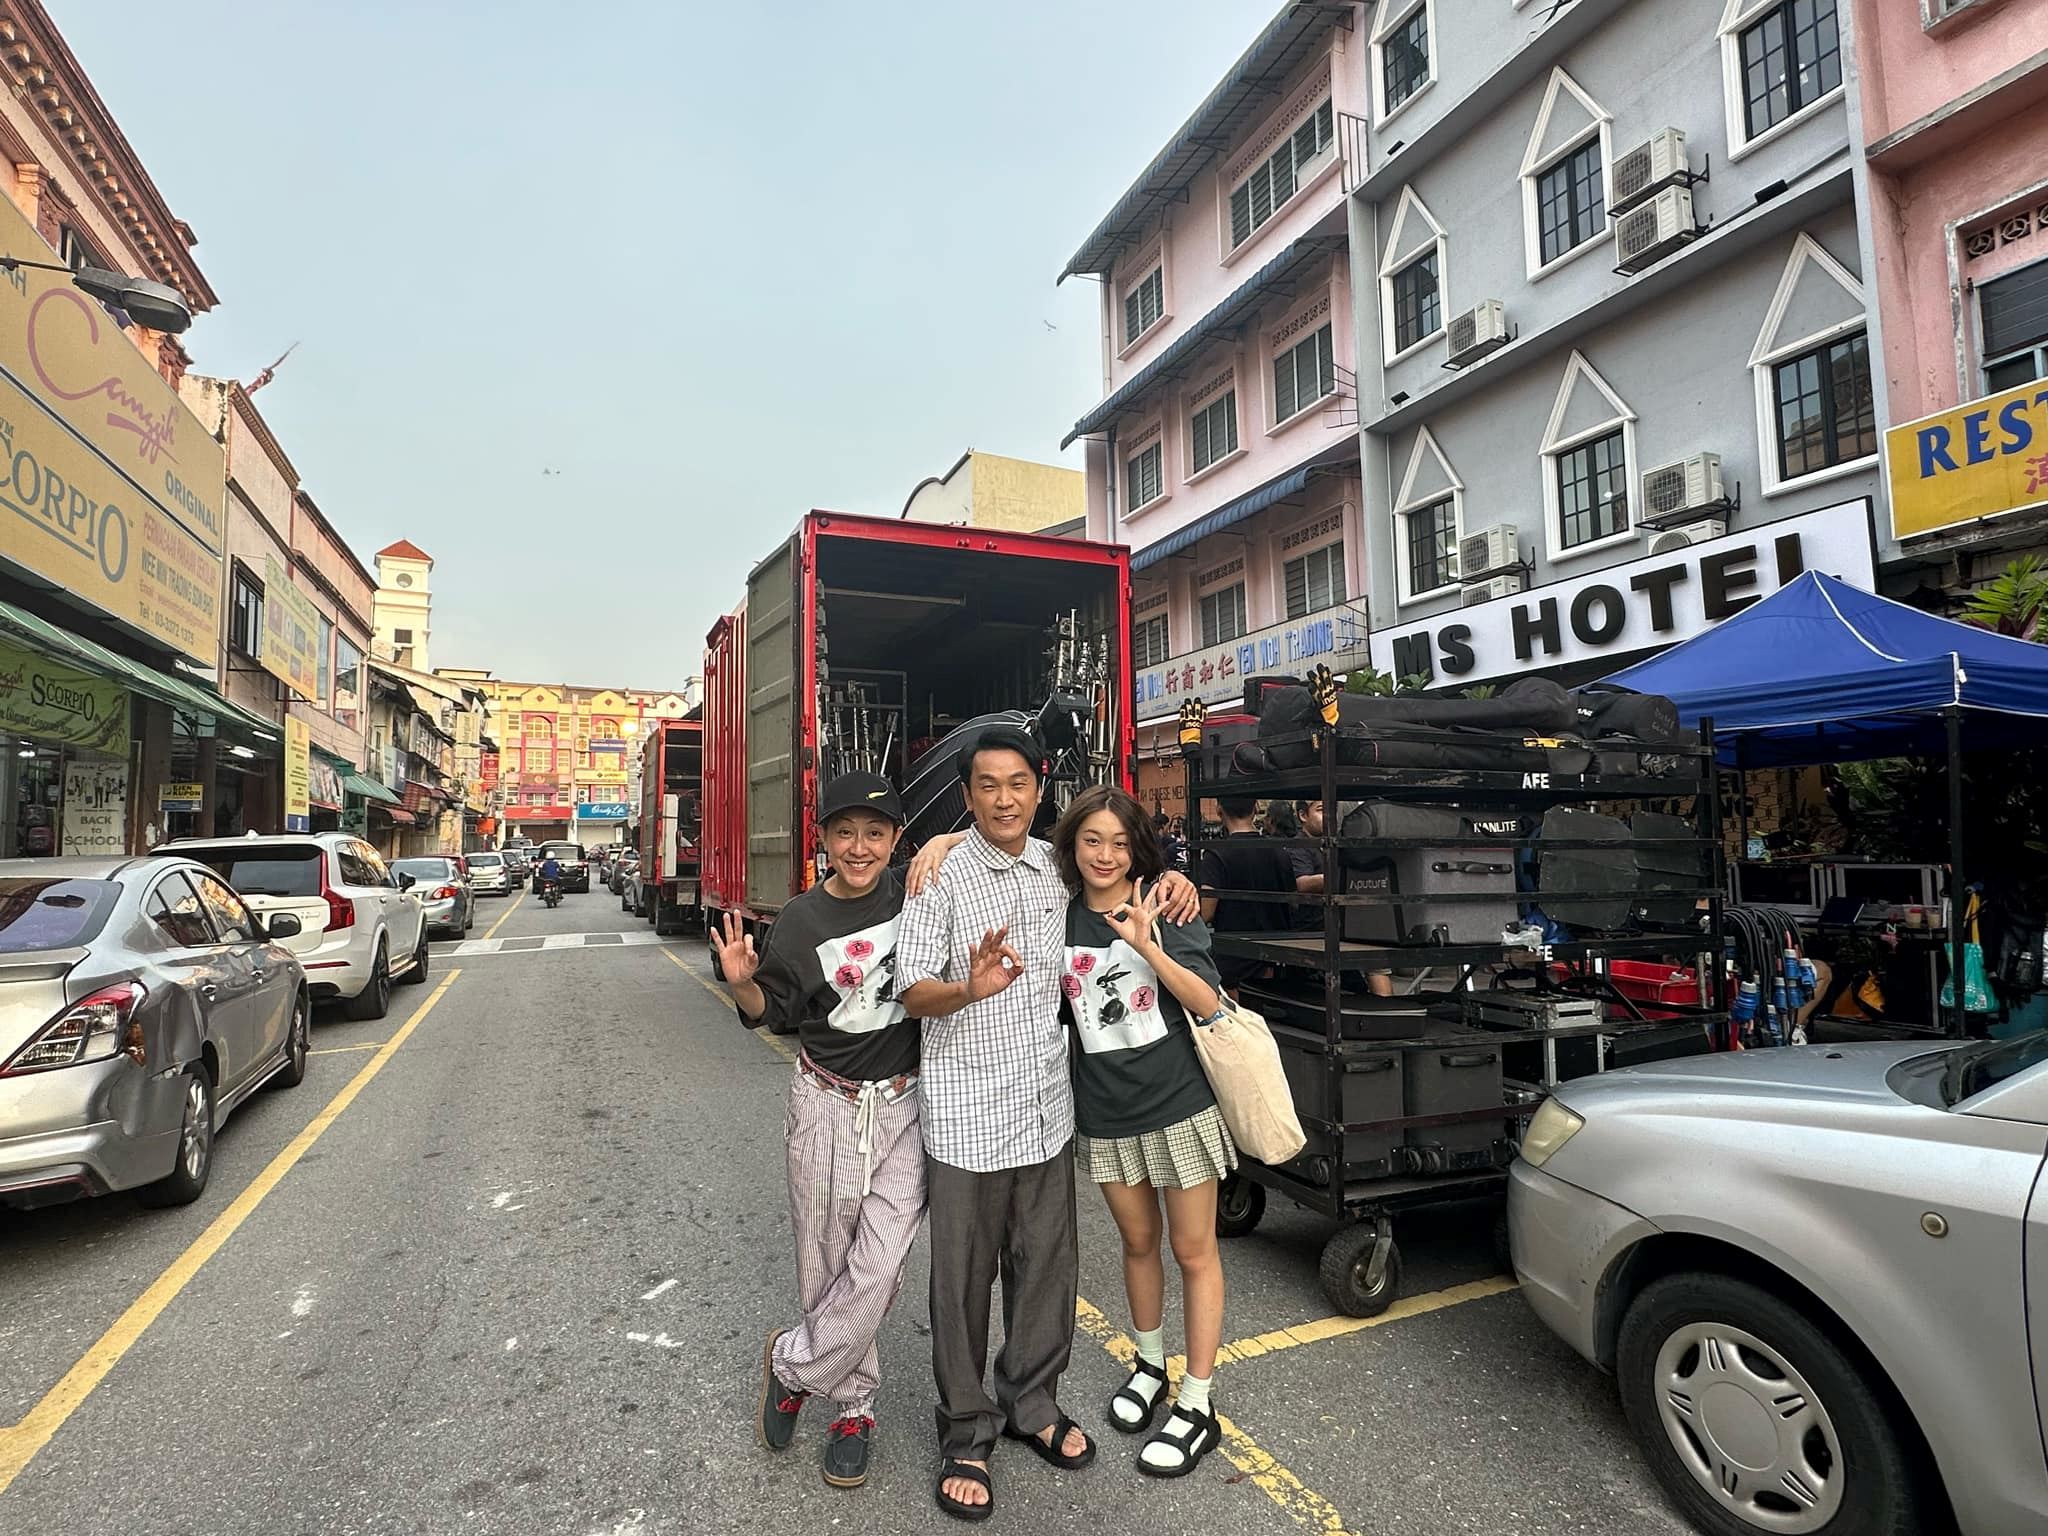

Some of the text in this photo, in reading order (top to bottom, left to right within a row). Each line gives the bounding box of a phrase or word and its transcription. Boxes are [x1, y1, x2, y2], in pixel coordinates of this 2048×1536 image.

[165, 469, 218, 537] ORIGINAL
[1285, 618, 1334, 663] TRADING
[1393, 624, 1475, 685] MS
[31, 673, 95, 722] SCORPIO
[64, 835, 125, 846] SCHOOL
[80, 815, 112, 825] BACK
